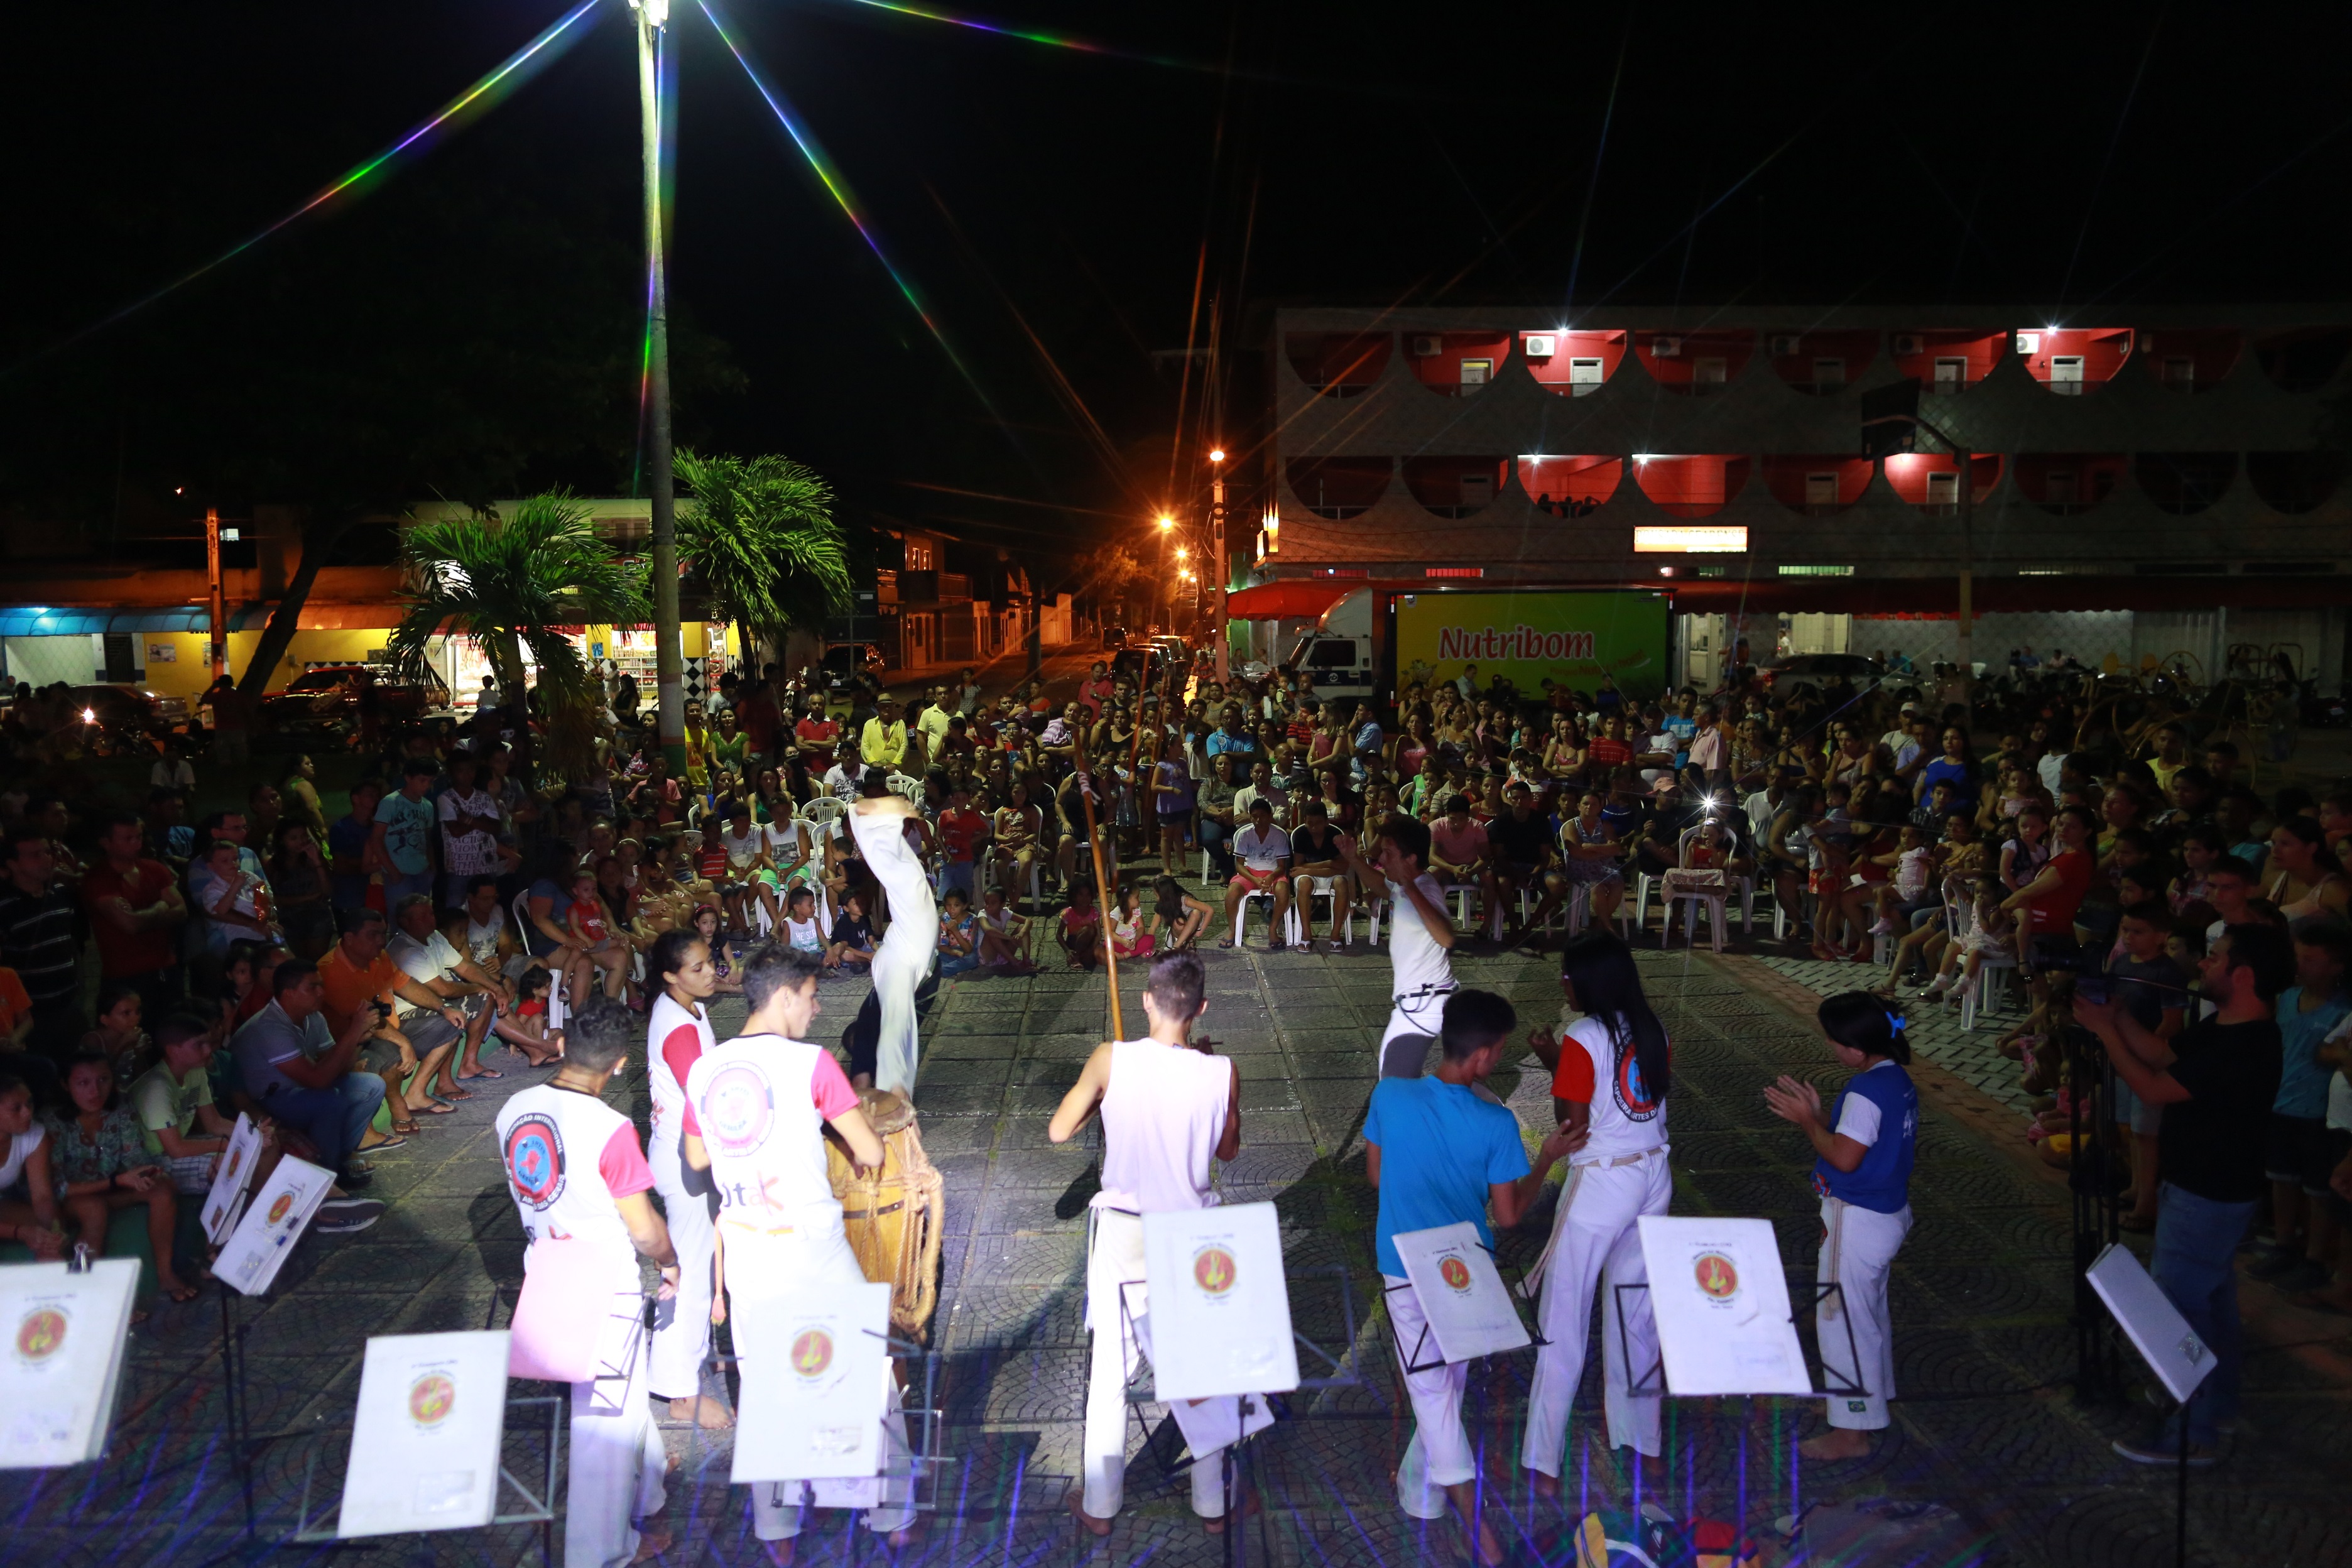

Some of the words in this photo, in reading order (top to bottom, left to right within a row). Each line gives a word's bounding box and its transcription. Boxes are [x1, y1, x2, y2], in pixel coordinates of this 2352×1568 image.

[1439, 625, 1594, 660] Nutribom
[1613, 1080, 1631, 1116] CAPOEIRA
[534, 1114, 564, 1155] INTERNACIONAL
[547, 1173, 565, 1203] GERAIS
